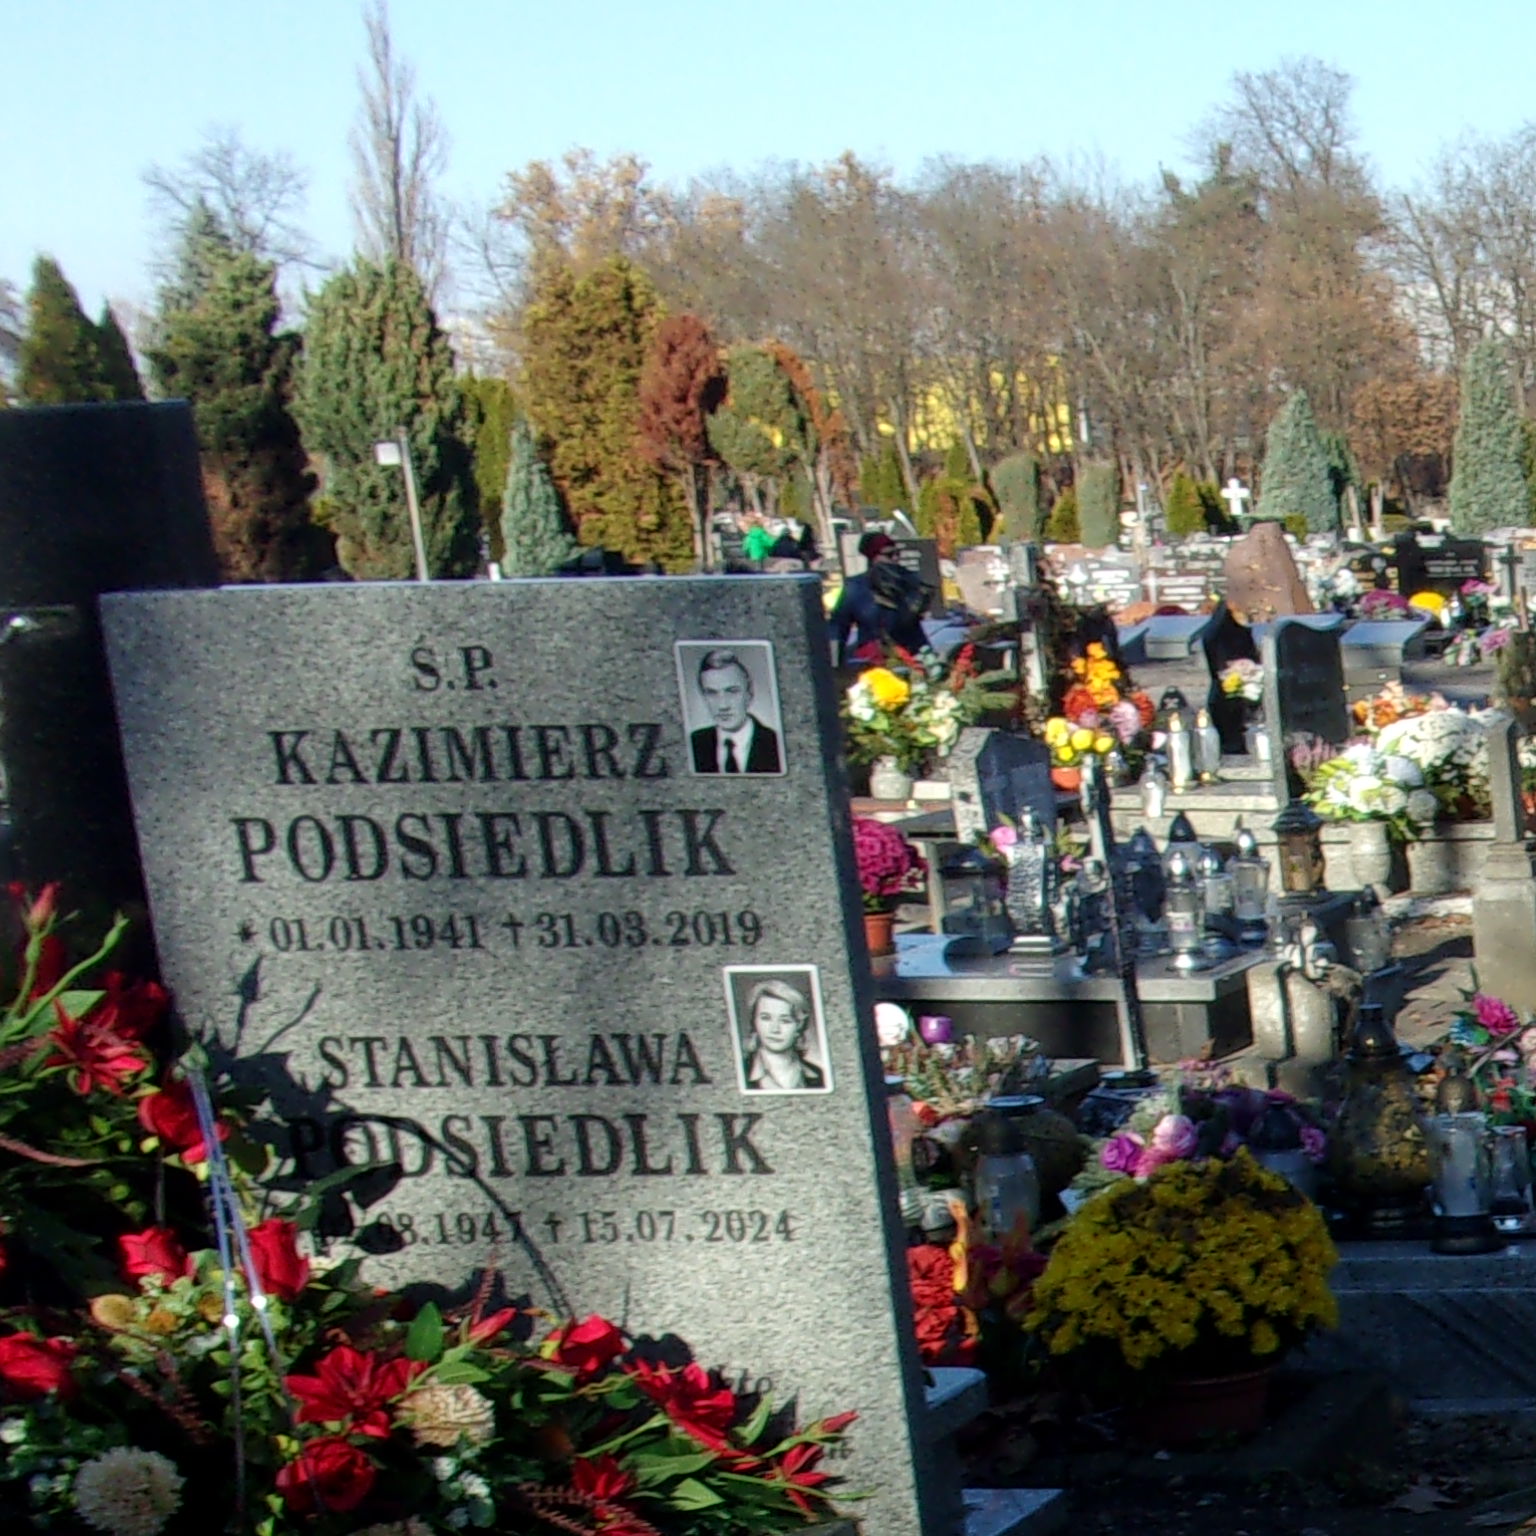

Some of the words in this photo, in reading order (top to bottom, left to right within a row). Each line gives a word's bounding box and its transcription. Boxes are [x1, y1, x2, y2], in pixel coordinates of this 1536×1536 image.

[269, 722, 671, 786] KAZIMIERZ
[231, 808, 737, 884] PODSIEDLIK
[269, 913, 482, 953] 01.01.1941
[536, 909, 765, 951] 31.03.2019
[318, 1031, 713, 1091] STANISŁAWA
[290, 1111, 776, 1180] PODSIEDLIK
[581, 1209, 798, 1247] 15.07.2024
